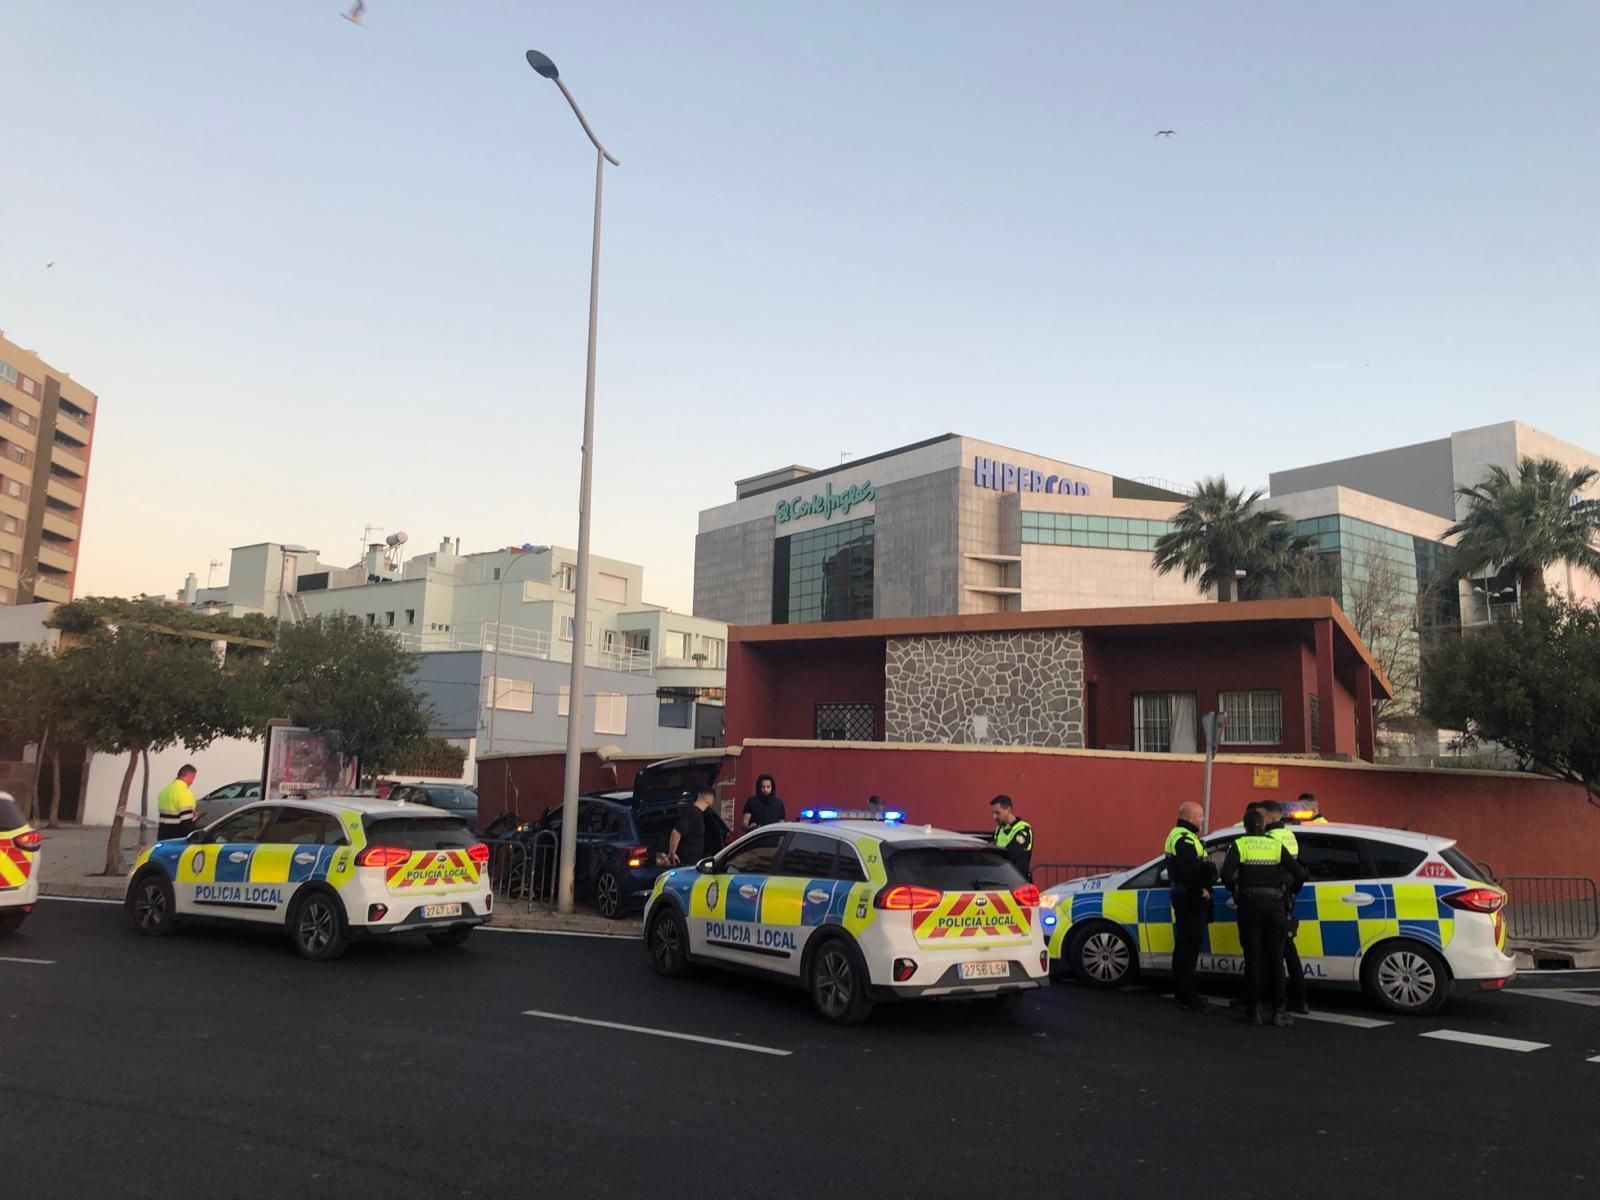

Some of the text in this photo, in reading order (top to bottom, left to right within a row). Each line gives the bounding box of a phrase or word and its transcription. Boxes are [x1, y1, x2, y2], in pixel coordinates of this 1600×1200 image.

[775, 500, 791, 524] El
[791, 495, 825, 520] Corte
[407, 868, 468, 880] POLICIA LOCAL
[195, 886, 284, 904] POLICIA LOCAL
[938, 915, 1015, 928] POLICIA LOCAL
[706, 921, 797, 950] POLICIA LOCAL
[964, 963, 988, 977] 2756
